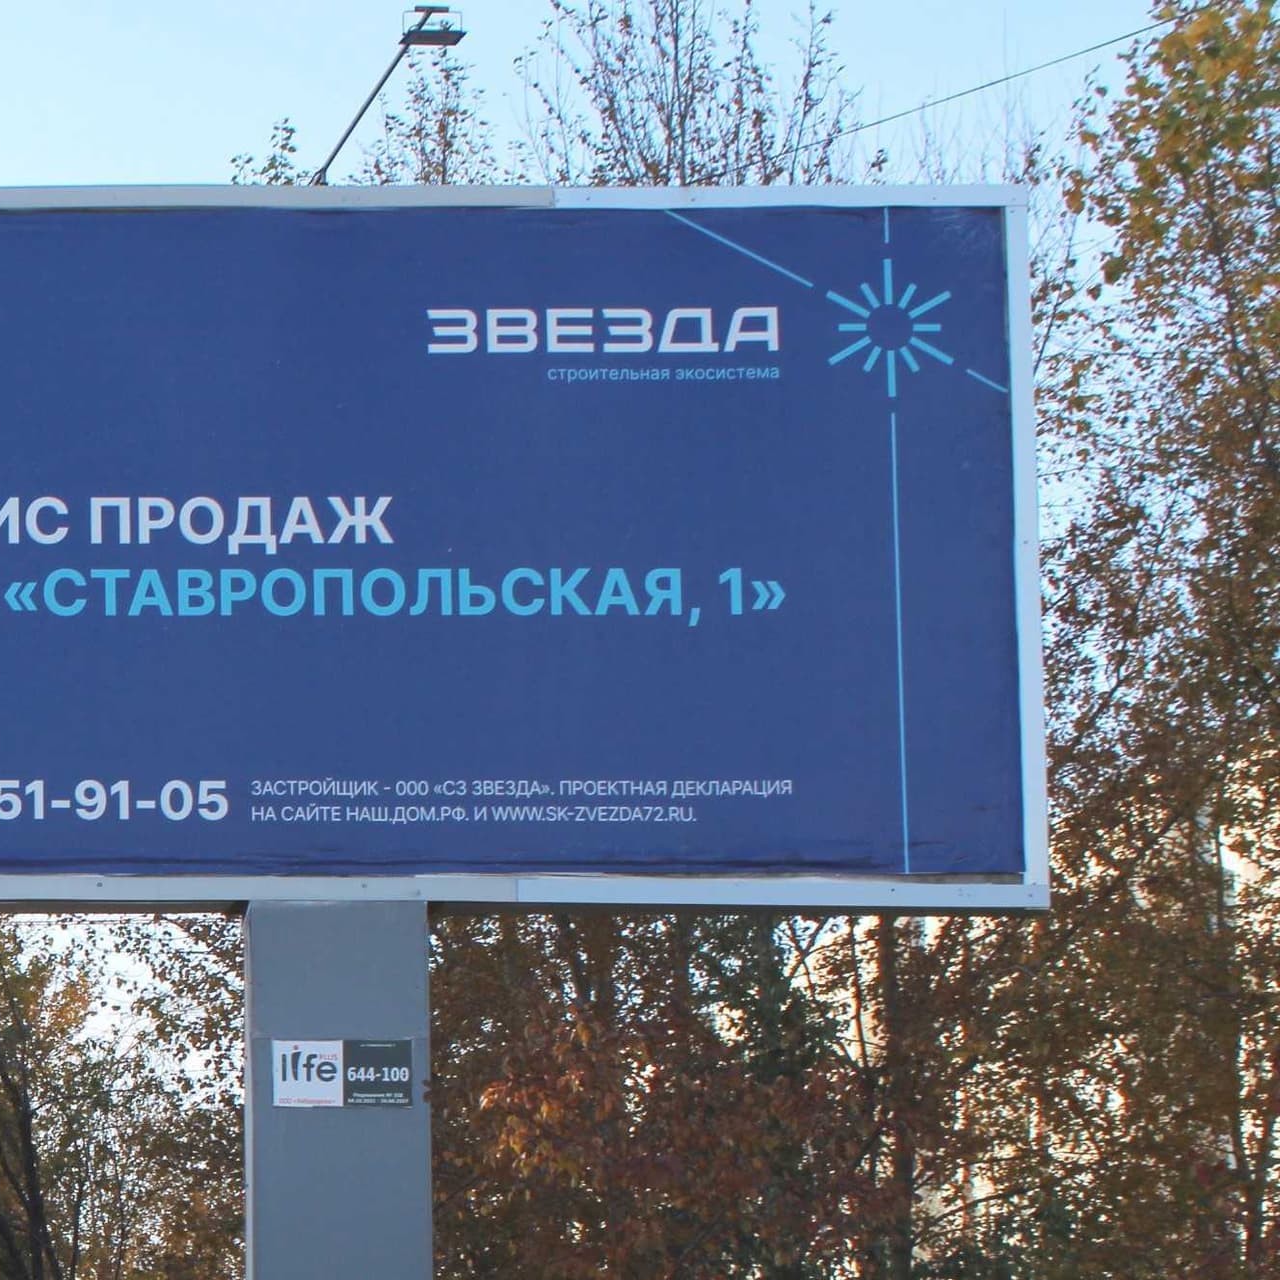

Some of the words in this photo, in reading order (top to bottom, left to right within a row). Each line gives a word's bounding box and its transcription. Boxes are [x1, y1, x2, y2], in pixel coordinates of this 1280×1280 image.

[427, 307, 779, 353] ЗВЕЗДА
[547, 368, 670, 382] строительная
[675, 366, 780, 380] экосистема
[90, 496, 394, 554] ПРОДАЖ
[4, 568, 700, 626] «СТАВРОПОЛЬСКАЯ,
[719, 568, 786, 615] 1»
[251, 778, 379, 798] ЗАСТРОЙЩИК
[395, 780, 429, 796] ООО
[433, 780, 467, 796] «СЗ
[471, 780, 555, 798] ЗВЕЗДА».
[559, 780, 667, 796] ПРОЕКТНАЯ
[670, 780, 793, 798] ДЕКЛАРАЦИЯ
[251, 806, 277, 821] НА
[280, 803, 342, 822] САЙТЕ
[473, 806, 487, 821] И
[491, 806, 697, 822] WWW.SK-ZVEZDA72.RU.
[347, 1067, 409, 1082] 644-100
